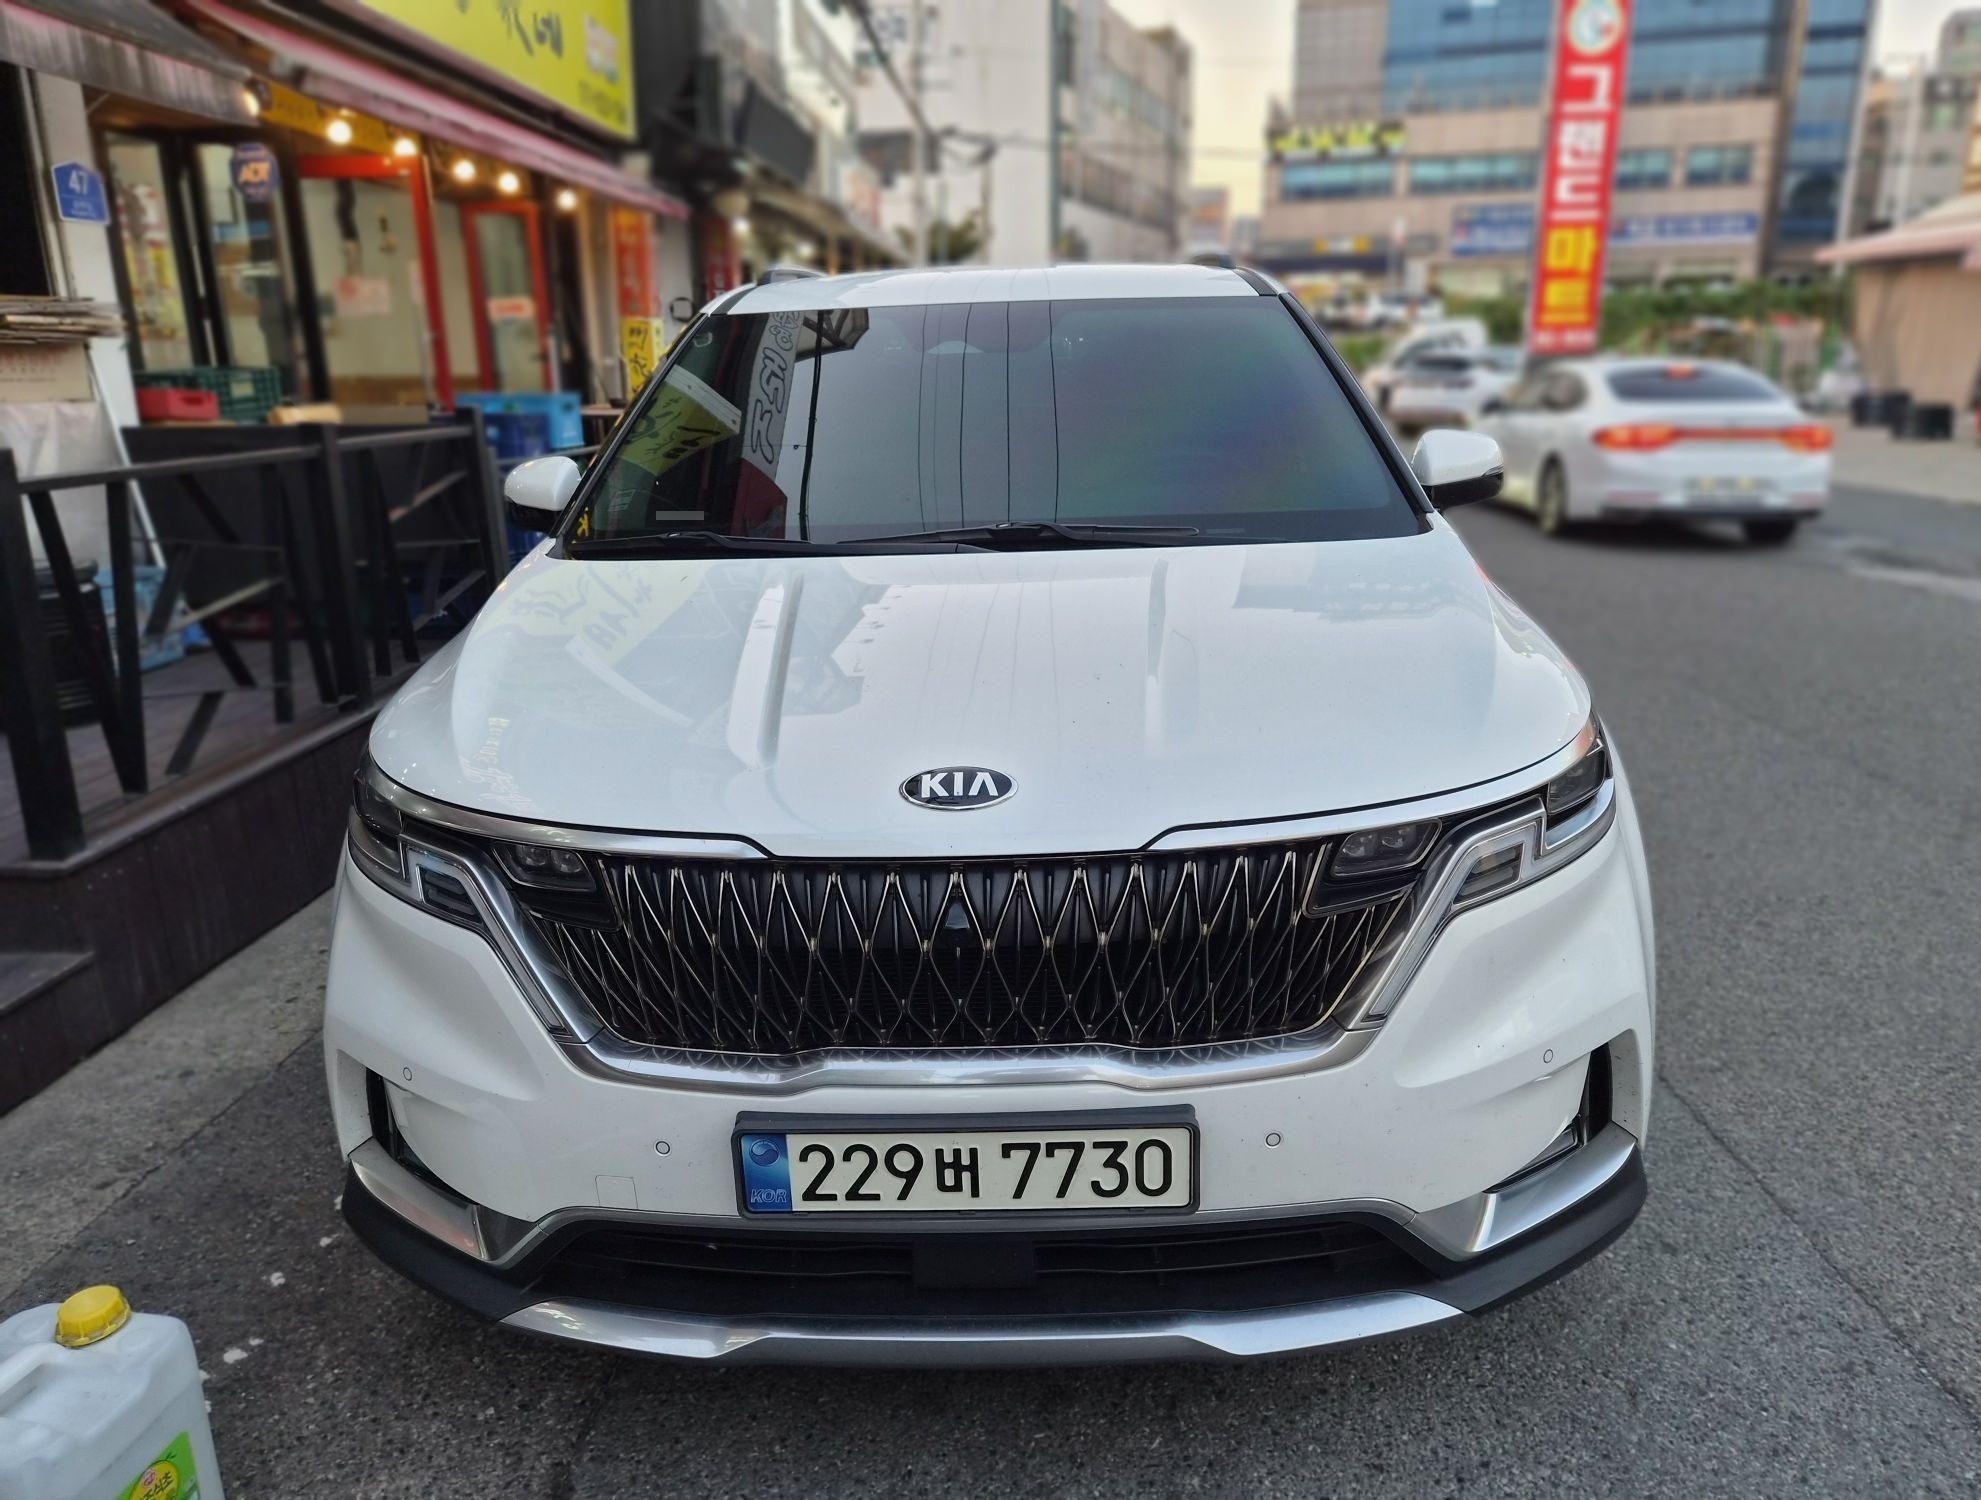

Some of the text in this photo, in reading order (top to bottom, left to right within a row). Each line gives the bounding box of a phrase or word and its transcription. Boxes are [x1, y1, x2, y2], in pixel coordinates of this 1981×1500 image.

[69, 170, 88, 195] 47
[921, 772, 999, 798] KIA
[1001, 1139, 1172, 1199] 7730
[750, 1188, 787, 1203] KOR
